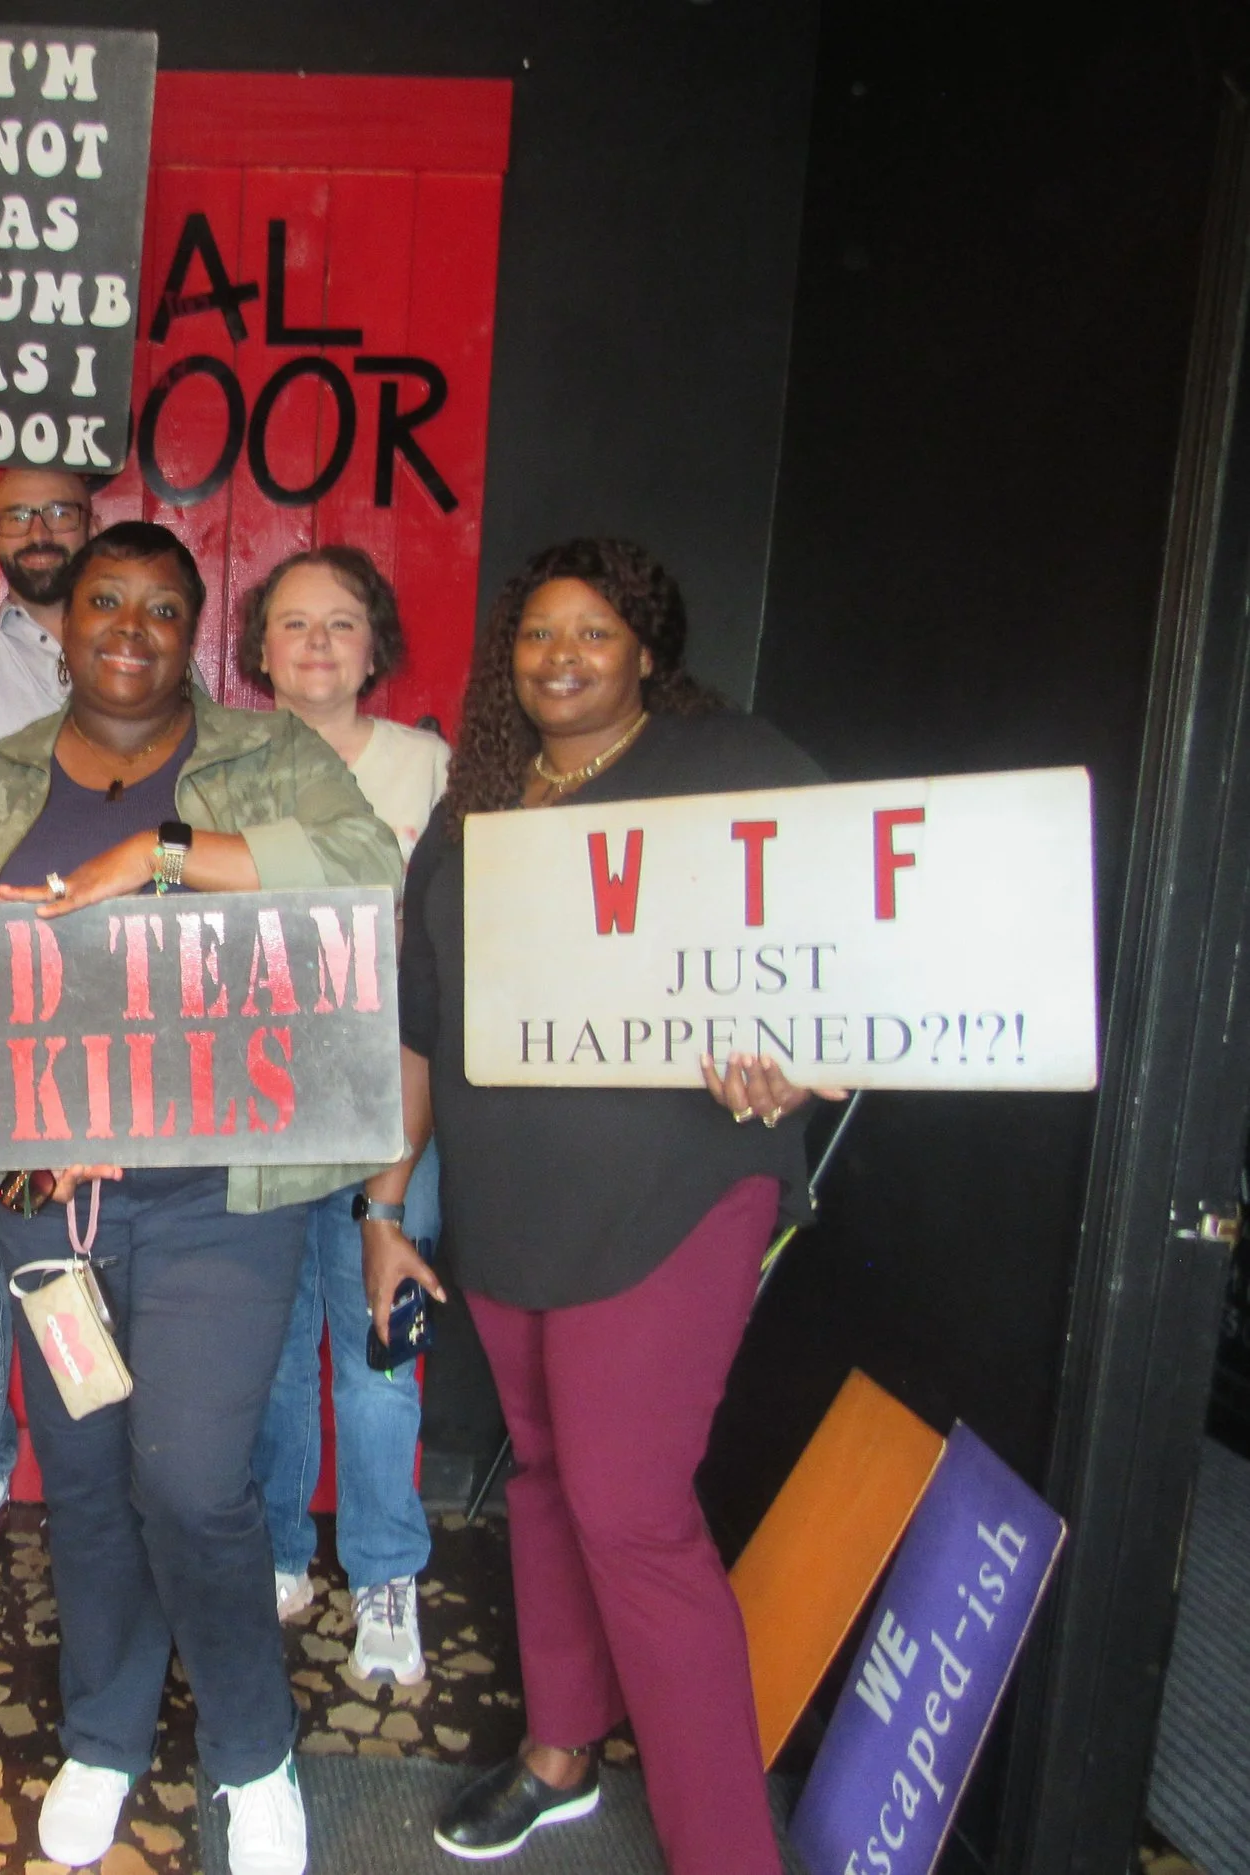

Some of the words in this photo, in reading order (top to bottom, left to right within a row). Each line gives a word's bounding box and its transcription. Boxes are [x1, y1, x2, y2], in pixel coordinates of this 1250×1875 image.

[71, 346, 97, 398] I
[88, 355, 459, 515] OOR
[108, 903, 381, 1021] TEAM
[665, 942, 838, 998] JUST
[517, 1010, 1026, 1067] HAPPENED?!?!
[855, 1609, 920, 1726] WE
